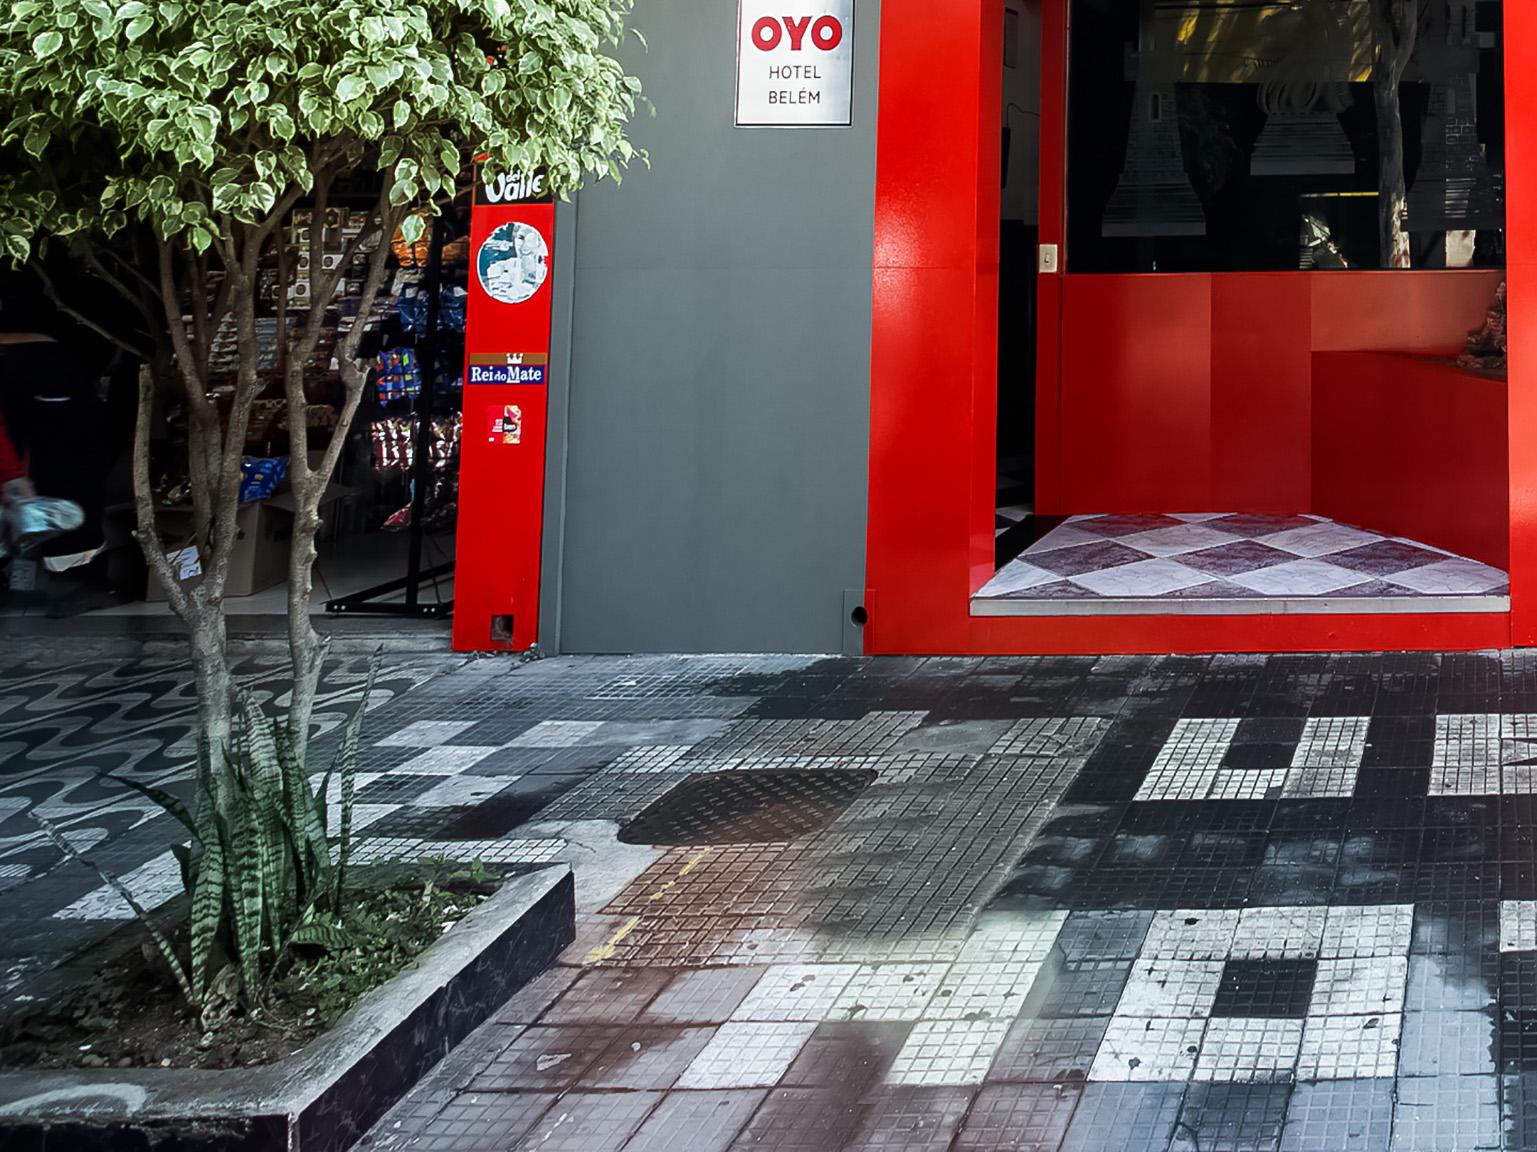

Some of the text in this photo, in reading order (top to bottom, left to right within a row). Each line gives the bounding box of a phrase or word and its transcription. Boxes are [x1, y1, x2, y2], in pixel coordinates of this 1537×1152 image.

[751, 15, 843, 51] OYO
[769, 65, 821, 79] HOTEL
[768, 87, 820, 104] BELÉM
[471, 366, 542, 383] Rei do Mate
